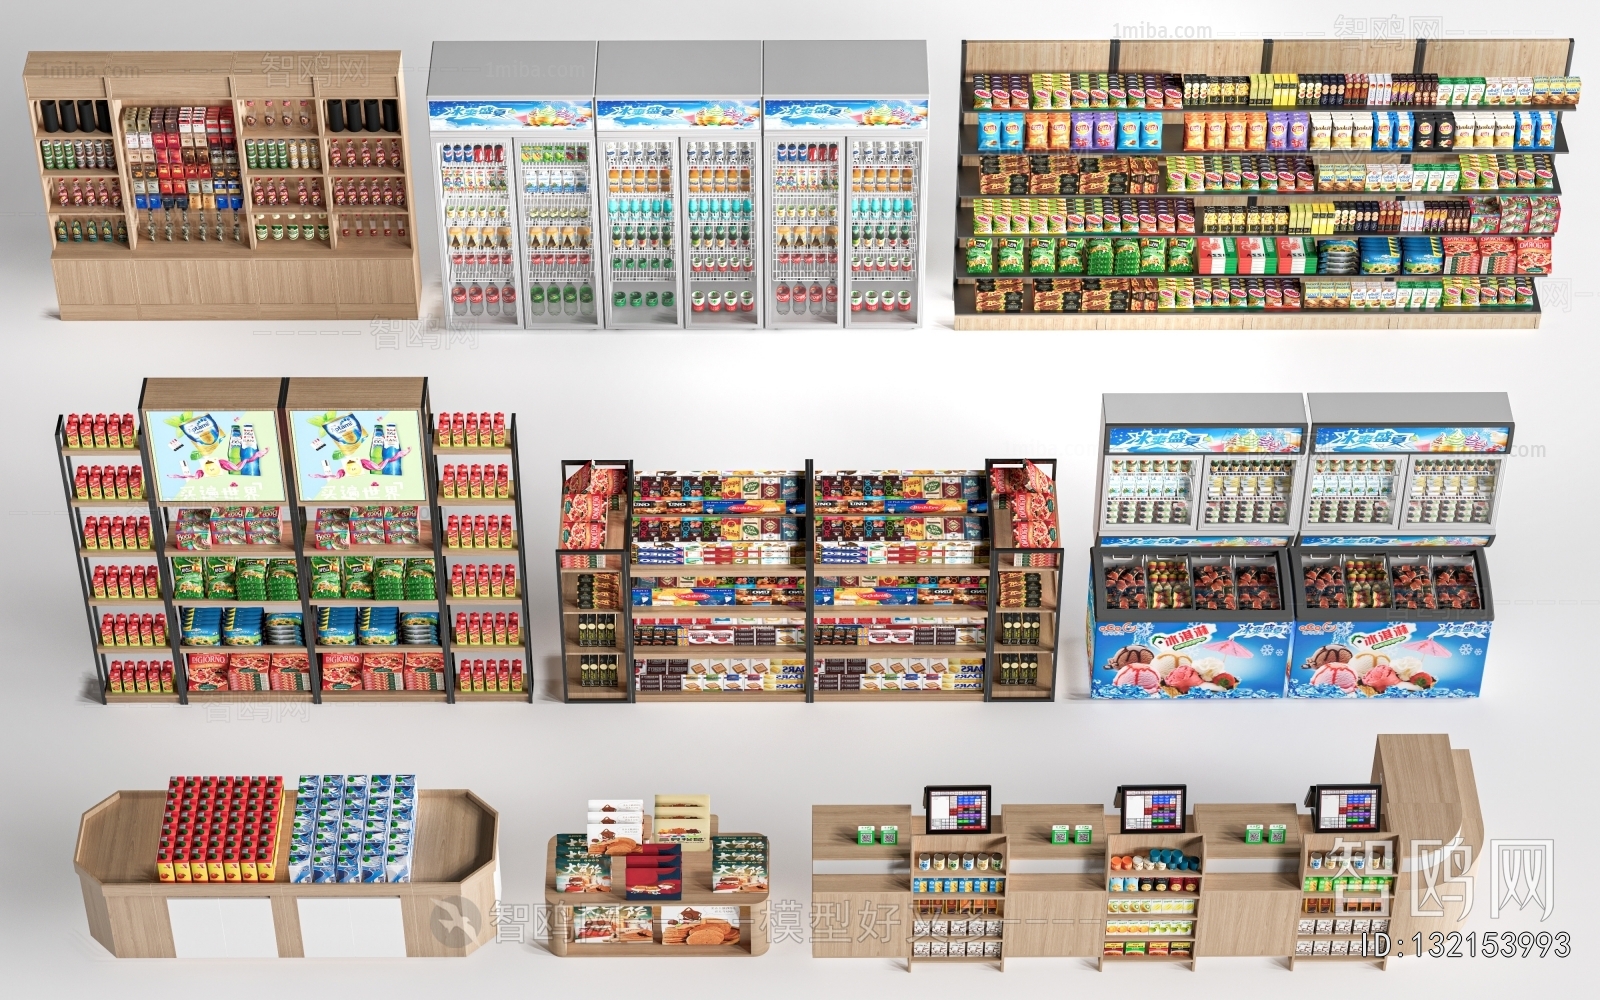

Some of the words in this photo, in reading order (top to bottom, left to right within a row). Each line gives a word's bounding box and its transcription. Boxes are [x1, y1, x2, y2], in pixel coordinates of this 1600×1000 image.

[180, 485, 260, 500] 买遍世界
[320, 485, 401, 500] 买遍世界
[1165, 625, 1210, 648] 冰淇淋
[1364, 624, 1410, 647] 冰淇淋
